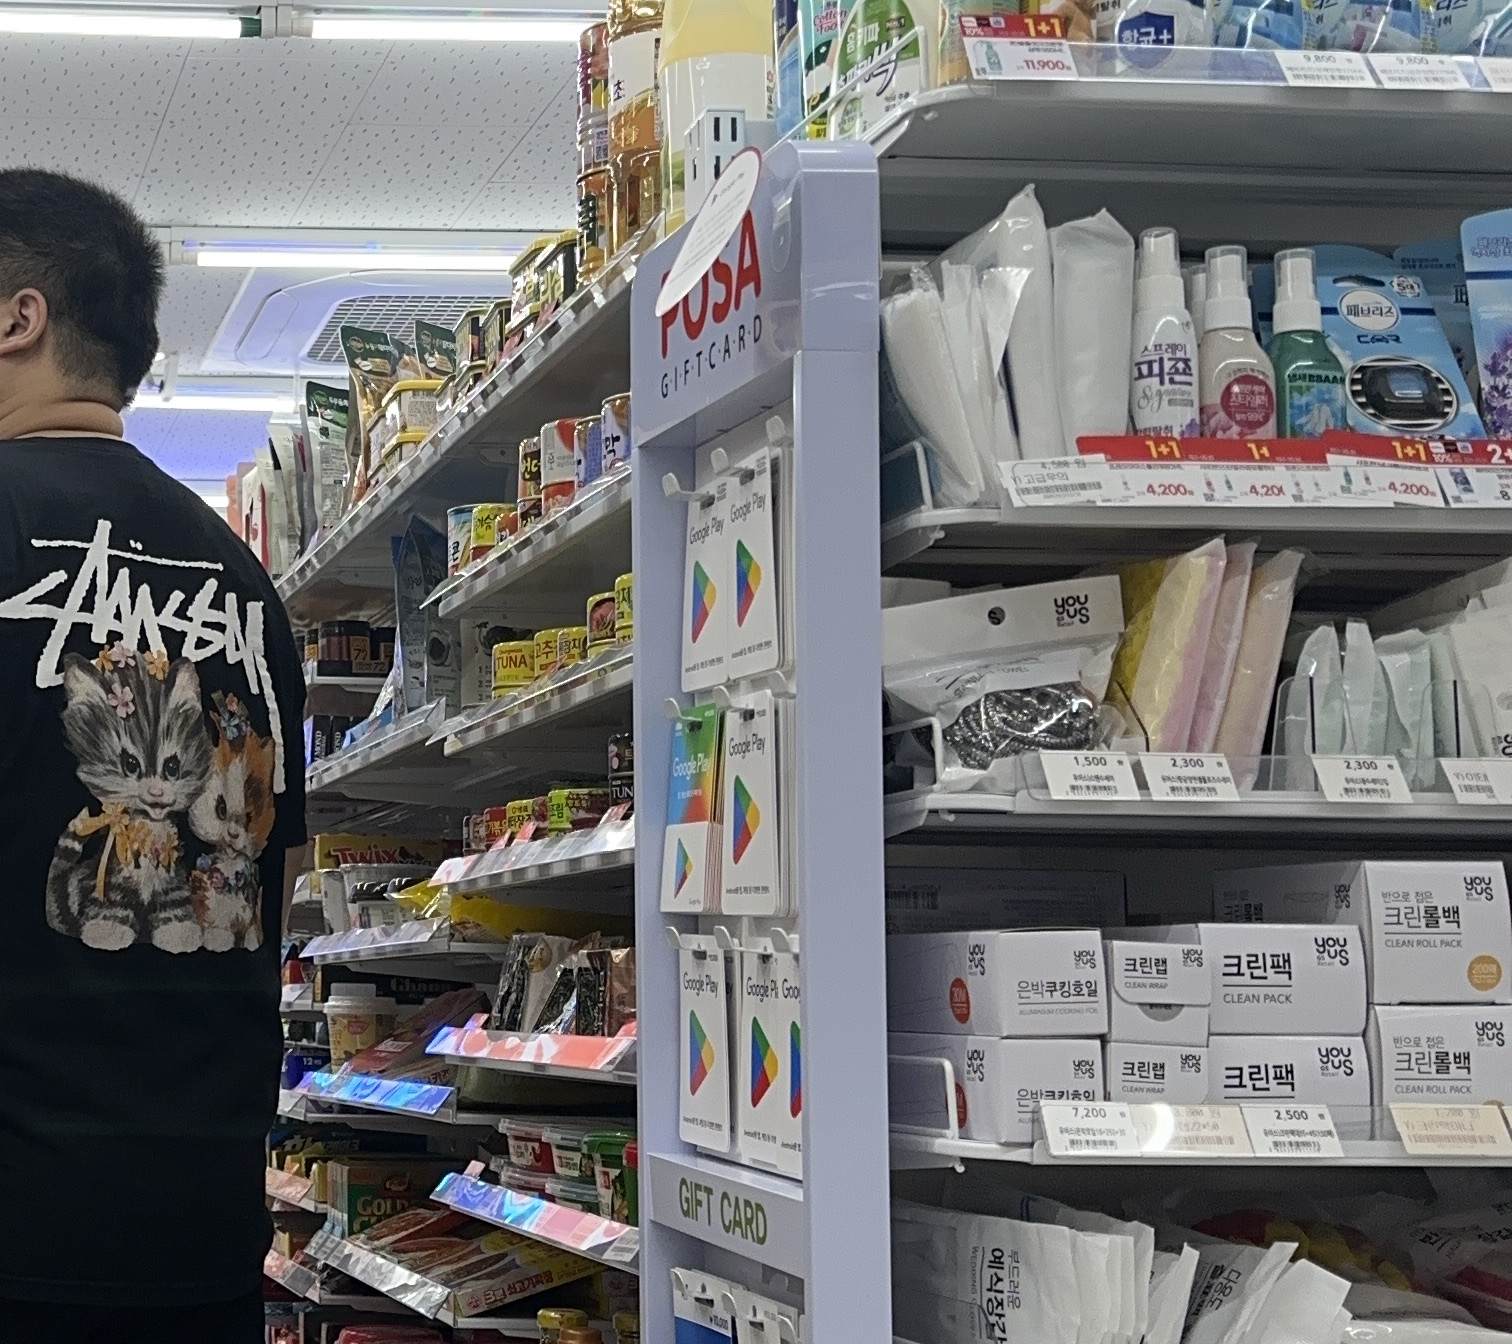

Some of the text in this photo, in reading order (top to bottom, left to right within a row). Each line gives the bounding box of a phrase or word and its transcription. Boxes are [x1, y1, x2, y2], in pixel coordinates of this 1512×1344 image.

[1024, 17, 1061, 40] 1+1
[1024, 59, 1065, 73] 11,900
[1302, 53, 1337, 65] 9,800
[1395, 56, 1430, 68] 9,800
[1345, 303, 1396, 319] 페브리즈
[1356, 333, 1403, 346] CAR
[1141, 342, 1188, 357] 스프레이
[1133, 356, 1194, 388] 피죤
[1144, 439, 1182, 459] 1+1
[1392, 442, 1428, 461] 1+1
[1145, 482, 1187, 497] 4,200
[1387, 481, 1430, 497] 4,200
[731, 493, 766, 523] Google Play
[689, 517, 725, 545] Google Play
[495, 651, 529, 671] TUNA
[728, 734, 766, 759] Google Play
[672, 754, 697, 780] Google
[1073, 756, 1107, 768] 1,500
[1170, 758, 1205, 770] 2,300
[1344, 760, 1378, 772] 2,300
[330, 845, 398, 864] Twix
[1381, 890, 1435, 904] 반으로 접은
[1383, 905, 1461, 930] 크린롤백
[1384, 938, 1463, 949] CLEAN ROLL PACK
[1123, 957, 1169, 976] 크린랩
[1222, 952, 1293, 981] 크린팩
[683, 970, 719, 998] Google Play
[746, 977, 769, 1003] Google
[1016, 979, 1099, 999] 은박쿠킹호일
[1124, 981, 1169, 991] CLEAN WRAP
[1222, 993, 1293, 1004] CLEAN PACK
[1392, 1036, 1445, 1050] 반으로 접은
[1121, 1061, 1166, 1081] 크린랩
[1394, 1050, 1472, 1076] 크린롤백
[1223, 1063, 1296, 1092] 크린팩
[1121, 1085, 1144, 1094] CLEAN
[1394, 1084, 1473, 1095] CLEAN ROLL PACK
[1072, 1106, 1107, 1120] 7,200
[1274, 1109, 1309, 1122] 2,500
[678, 1176, 769, 1247] GIFT CARD
